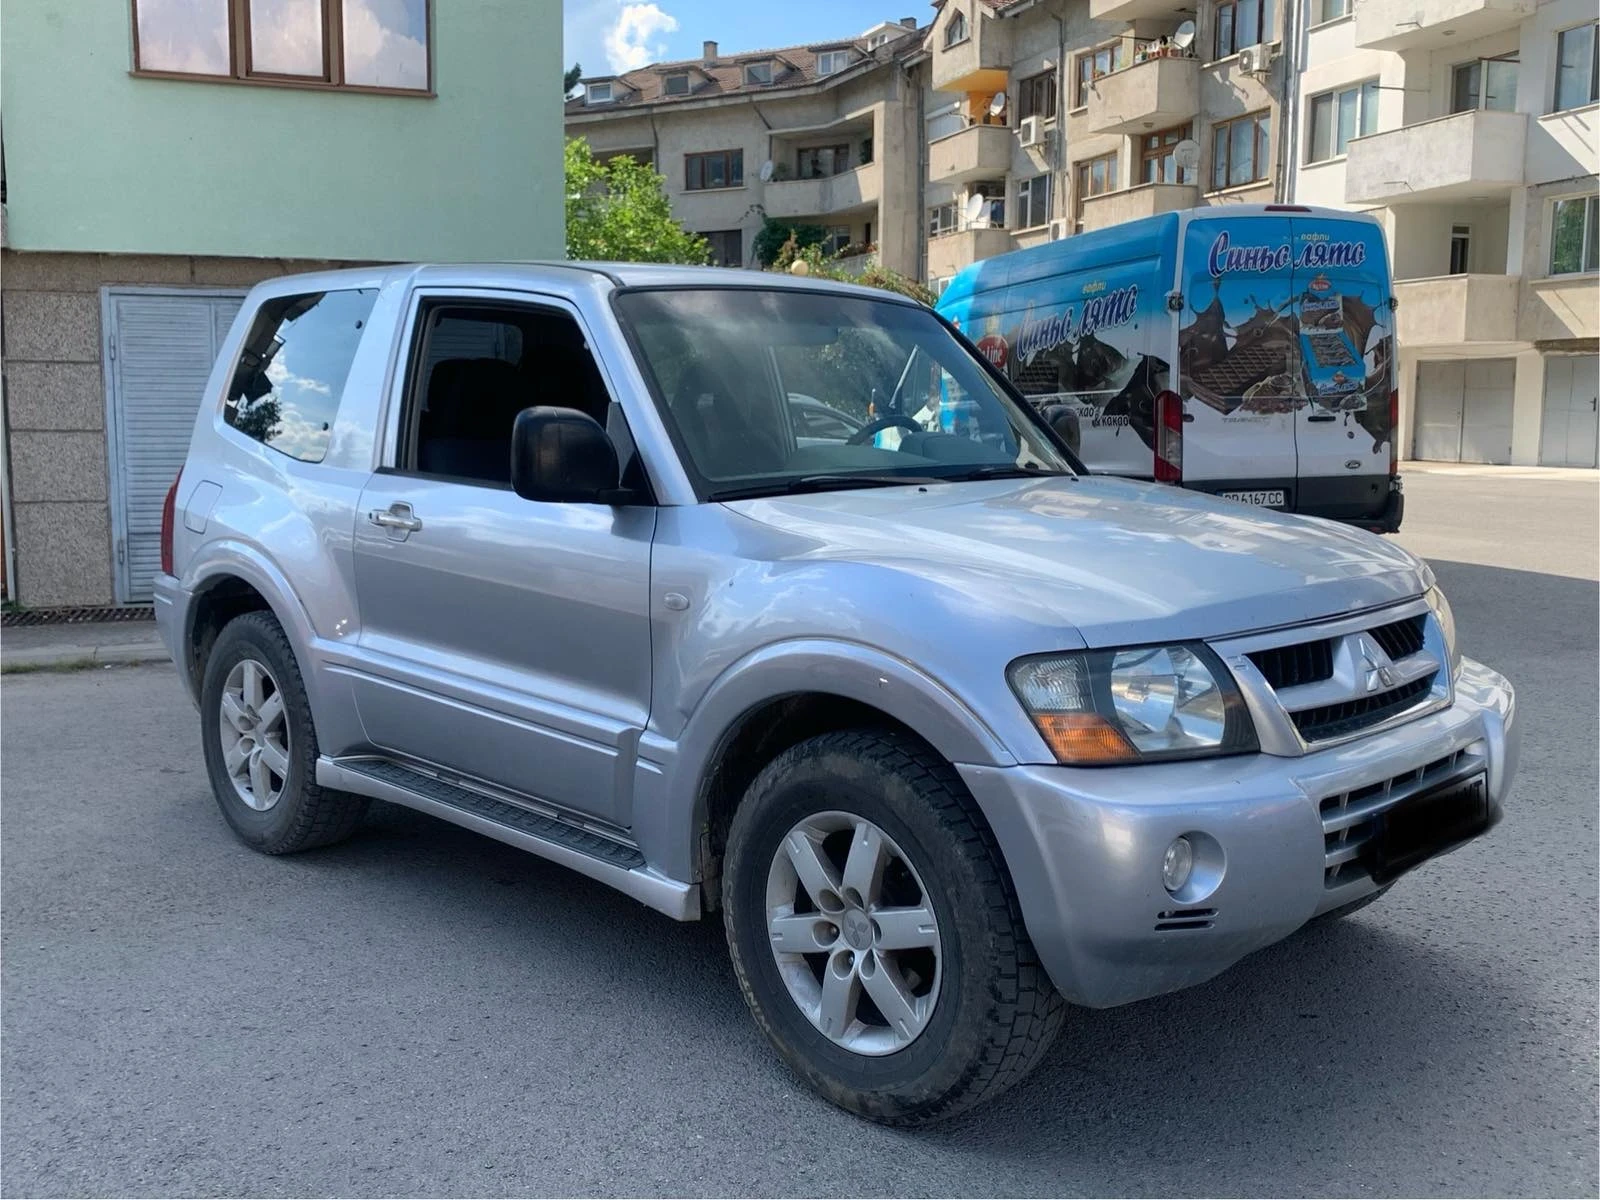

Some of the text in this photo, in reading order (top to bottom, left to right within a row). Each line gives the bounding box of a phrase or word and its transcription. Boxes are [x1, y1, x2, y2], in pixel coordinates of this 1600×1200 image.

[1208, 230, 1367, 278] Синьо лято
[1016, 284, 1138, 361] Синьо лято
